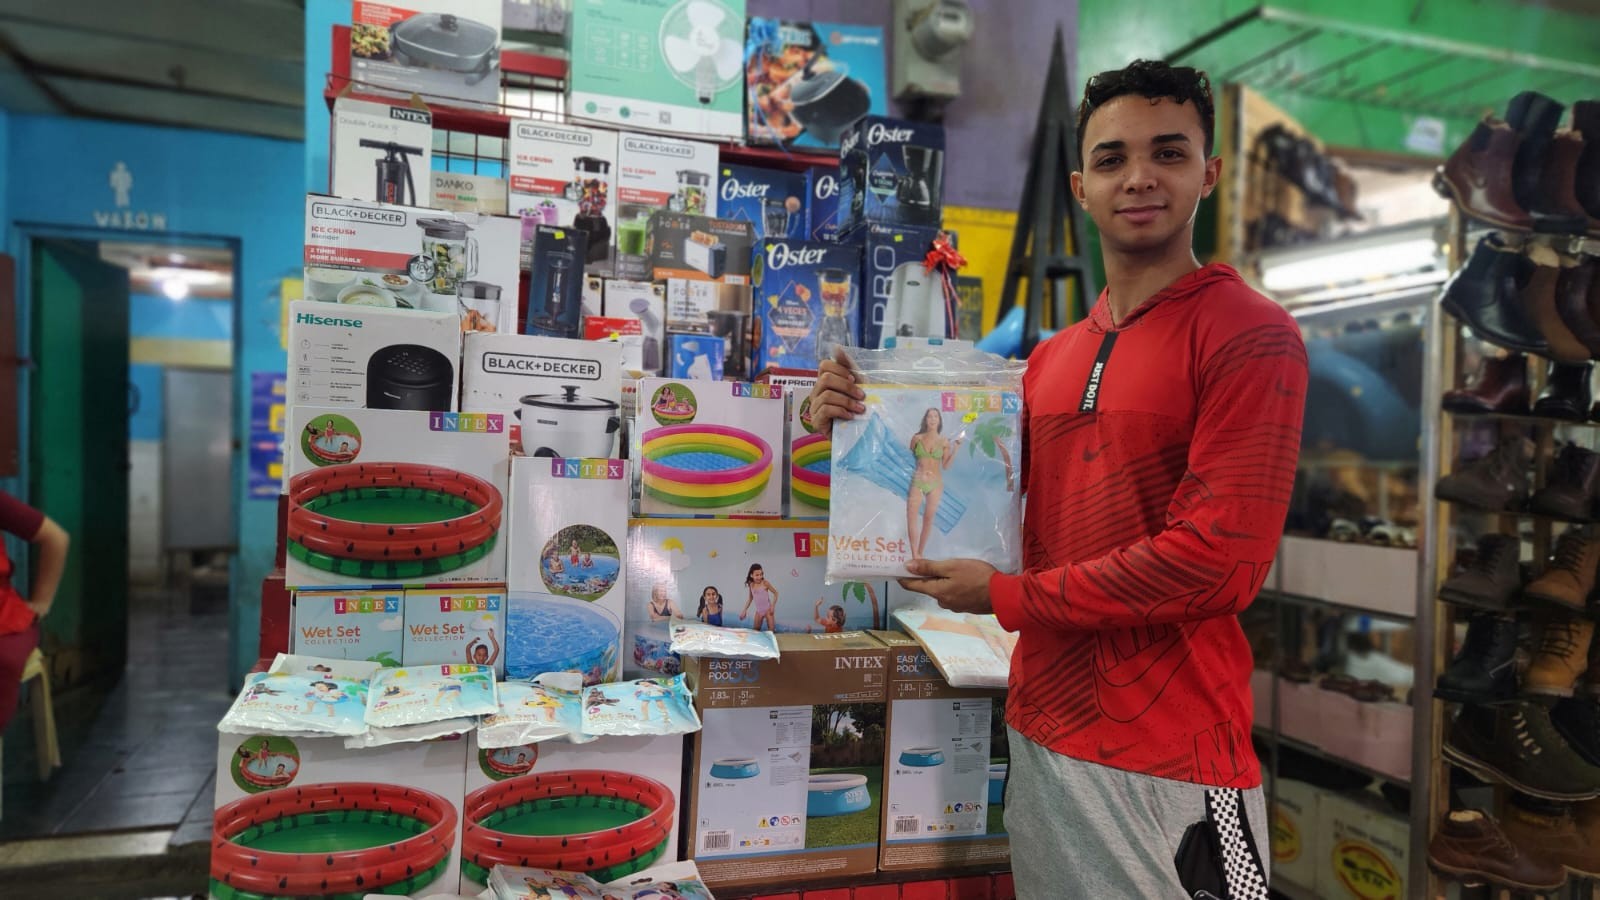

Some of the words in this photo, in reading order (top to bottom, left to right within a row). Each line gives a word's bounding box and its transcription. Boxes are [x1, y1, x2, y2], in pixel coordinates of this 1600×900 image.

[393, 109, 428, 123] INTEX
[520, 129, 590, 143] BLACK+DECKER
[867, 123, 914, 145] Oster
[627, 141, 693, 155] BLACK+DECKER
[720, 178, 770, 201] Oster
[315, 206, 403, 222] BLACK+DECKER
[311, 225, 326, 233] ICE
[327, 227, 357, 235] CRUSH
[767, 242, 827, 271] Oster
[296, 312, 363, 328] Hisense
[488, 357, 596, 375] BLACK+DECKER
[1090, 362, 1104, 384] JUST
[787, 379, 817, 387] PREM
[733, 383, 781, 398] INTEX
[1086, 384, 1098, 399] DO
[946, 395, 1018, 411] INTEX
[432, 415, 502, 432] INTEX
[554, 462, 621, 478] INTEX
[832, 535, 871, 552] Wet
[875, 537, 906, 553] Set
[836, 552, 905, 562] COLLECTION
[337, 599, 398, 612] INTEX
[442, 598, 499, 611] INTEX
[302, 626, 332, 638] Wet
[337, 625, 361, 637] Set
[410, 624, 439, 635] Wet
[442, 623, 466, 635] Set
[304, 637, 360, 645] COLLECTION
[411, 634, 465, 642] COLLECTION
[709, 661, 733, 670] EASY
[735, 661, 753, 669] SET
[834, 655, 884, 670] INTEX
[896, 655, 919, 664] EASY
[708, 671, 735, 681] POOL
[896, 665, 918, 673] POOL
